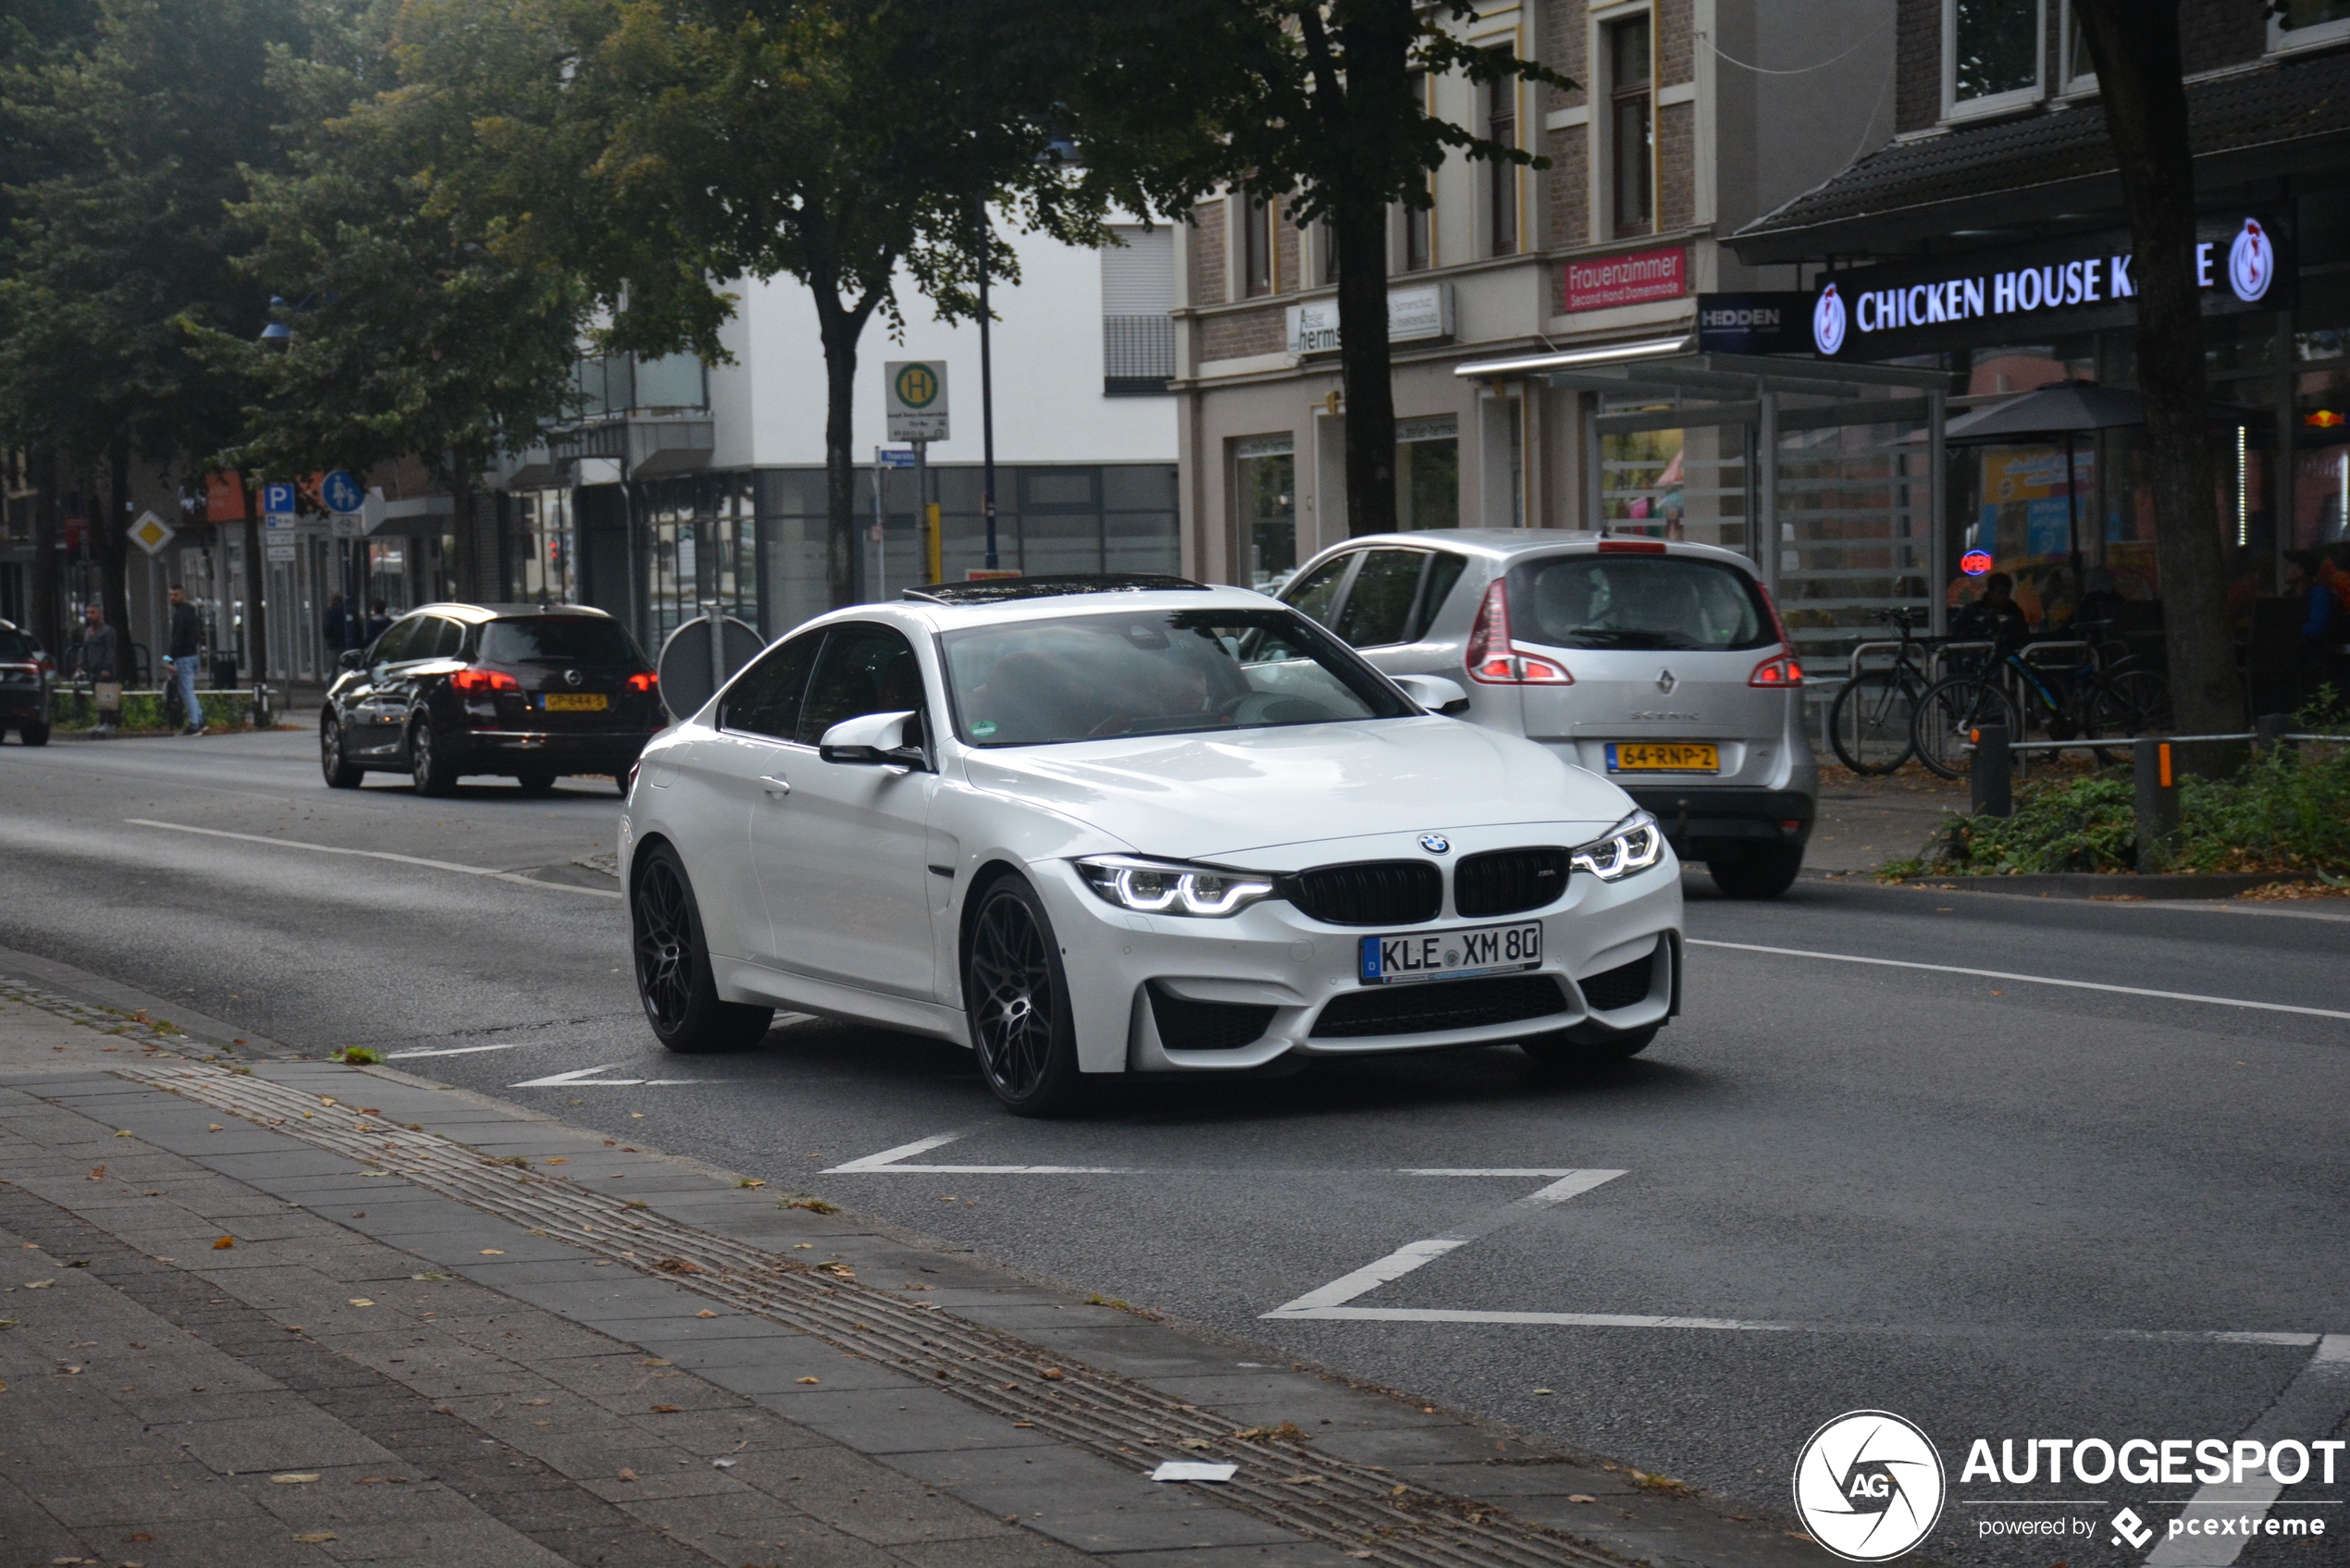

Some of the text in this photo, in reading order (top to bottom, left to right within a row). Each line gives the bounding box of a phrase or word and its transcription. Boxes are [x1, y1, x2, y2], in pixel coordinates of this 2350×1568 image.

[1569, 255, 1678, 290] Frauenzimmer
[1571, 281, 1679, 307] Second Hand Damenmode
[1857, 277, 1985, 333] CHICKEN
[1994, 258, 2101, 315] HOUSE
[1702, 308, 1780, 326] HIDDEN
[1299, 327, 1342, 351] herms
[908, 373, 926, 399] H
[270, 487, 287, 510] P
[1960, 555, 1992, 572] OPEN
[1624, 747, 1712, 766] 64-RNP-2
[1382, 928, 1538, 972] KLE XM 80
[1367, 961, 1376, 971] D
